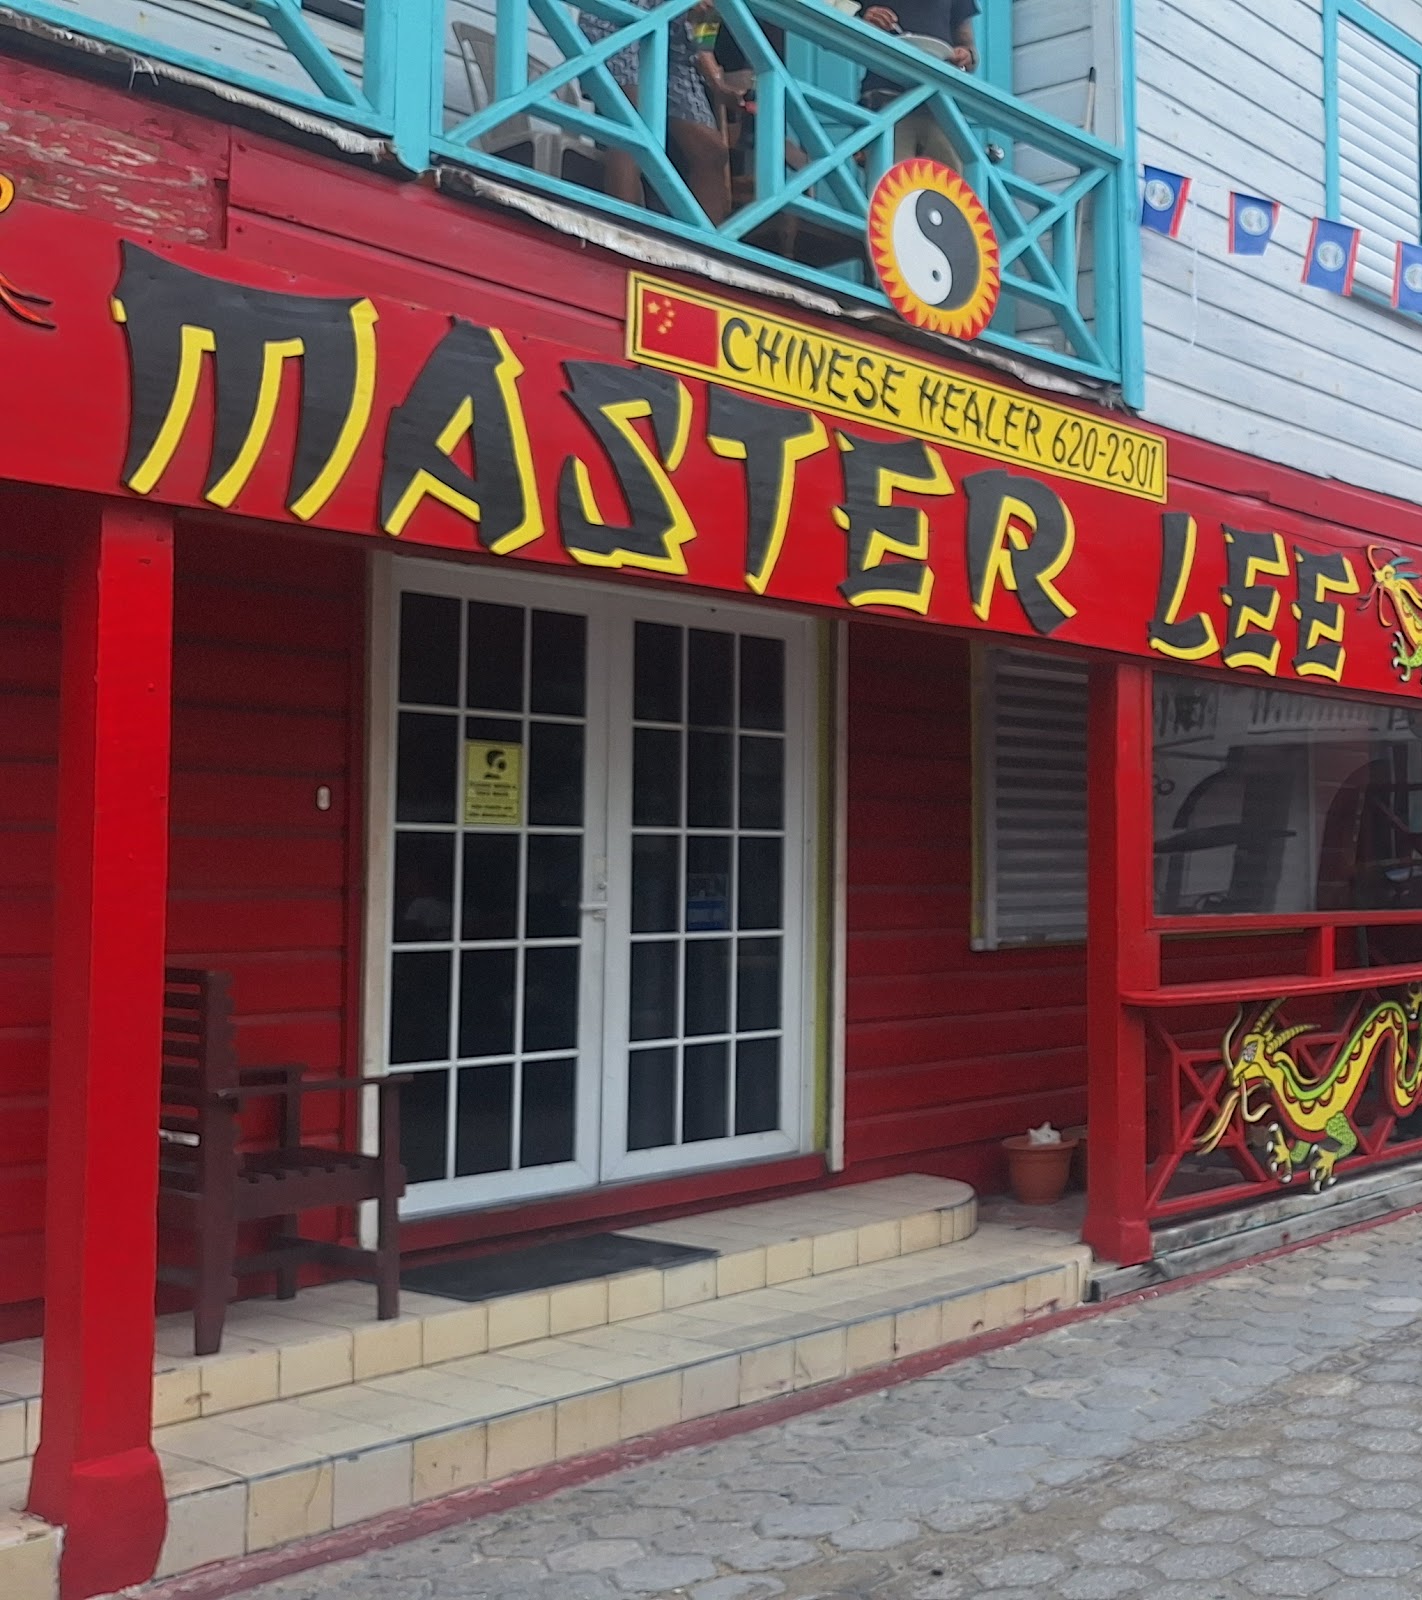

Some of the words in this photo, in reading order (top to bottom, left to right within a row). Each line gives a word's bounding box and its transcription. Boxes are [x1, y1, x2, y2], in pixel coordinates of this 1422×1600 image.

[111, 239, 1077, 634] MASTER
[1148, 511, 1360, 683] LEE
[721, 317, 906, 417] CHINESE
[918, 374, 1043, 459] HEALER
[1051, 418, 1159, 489] 620-2301
